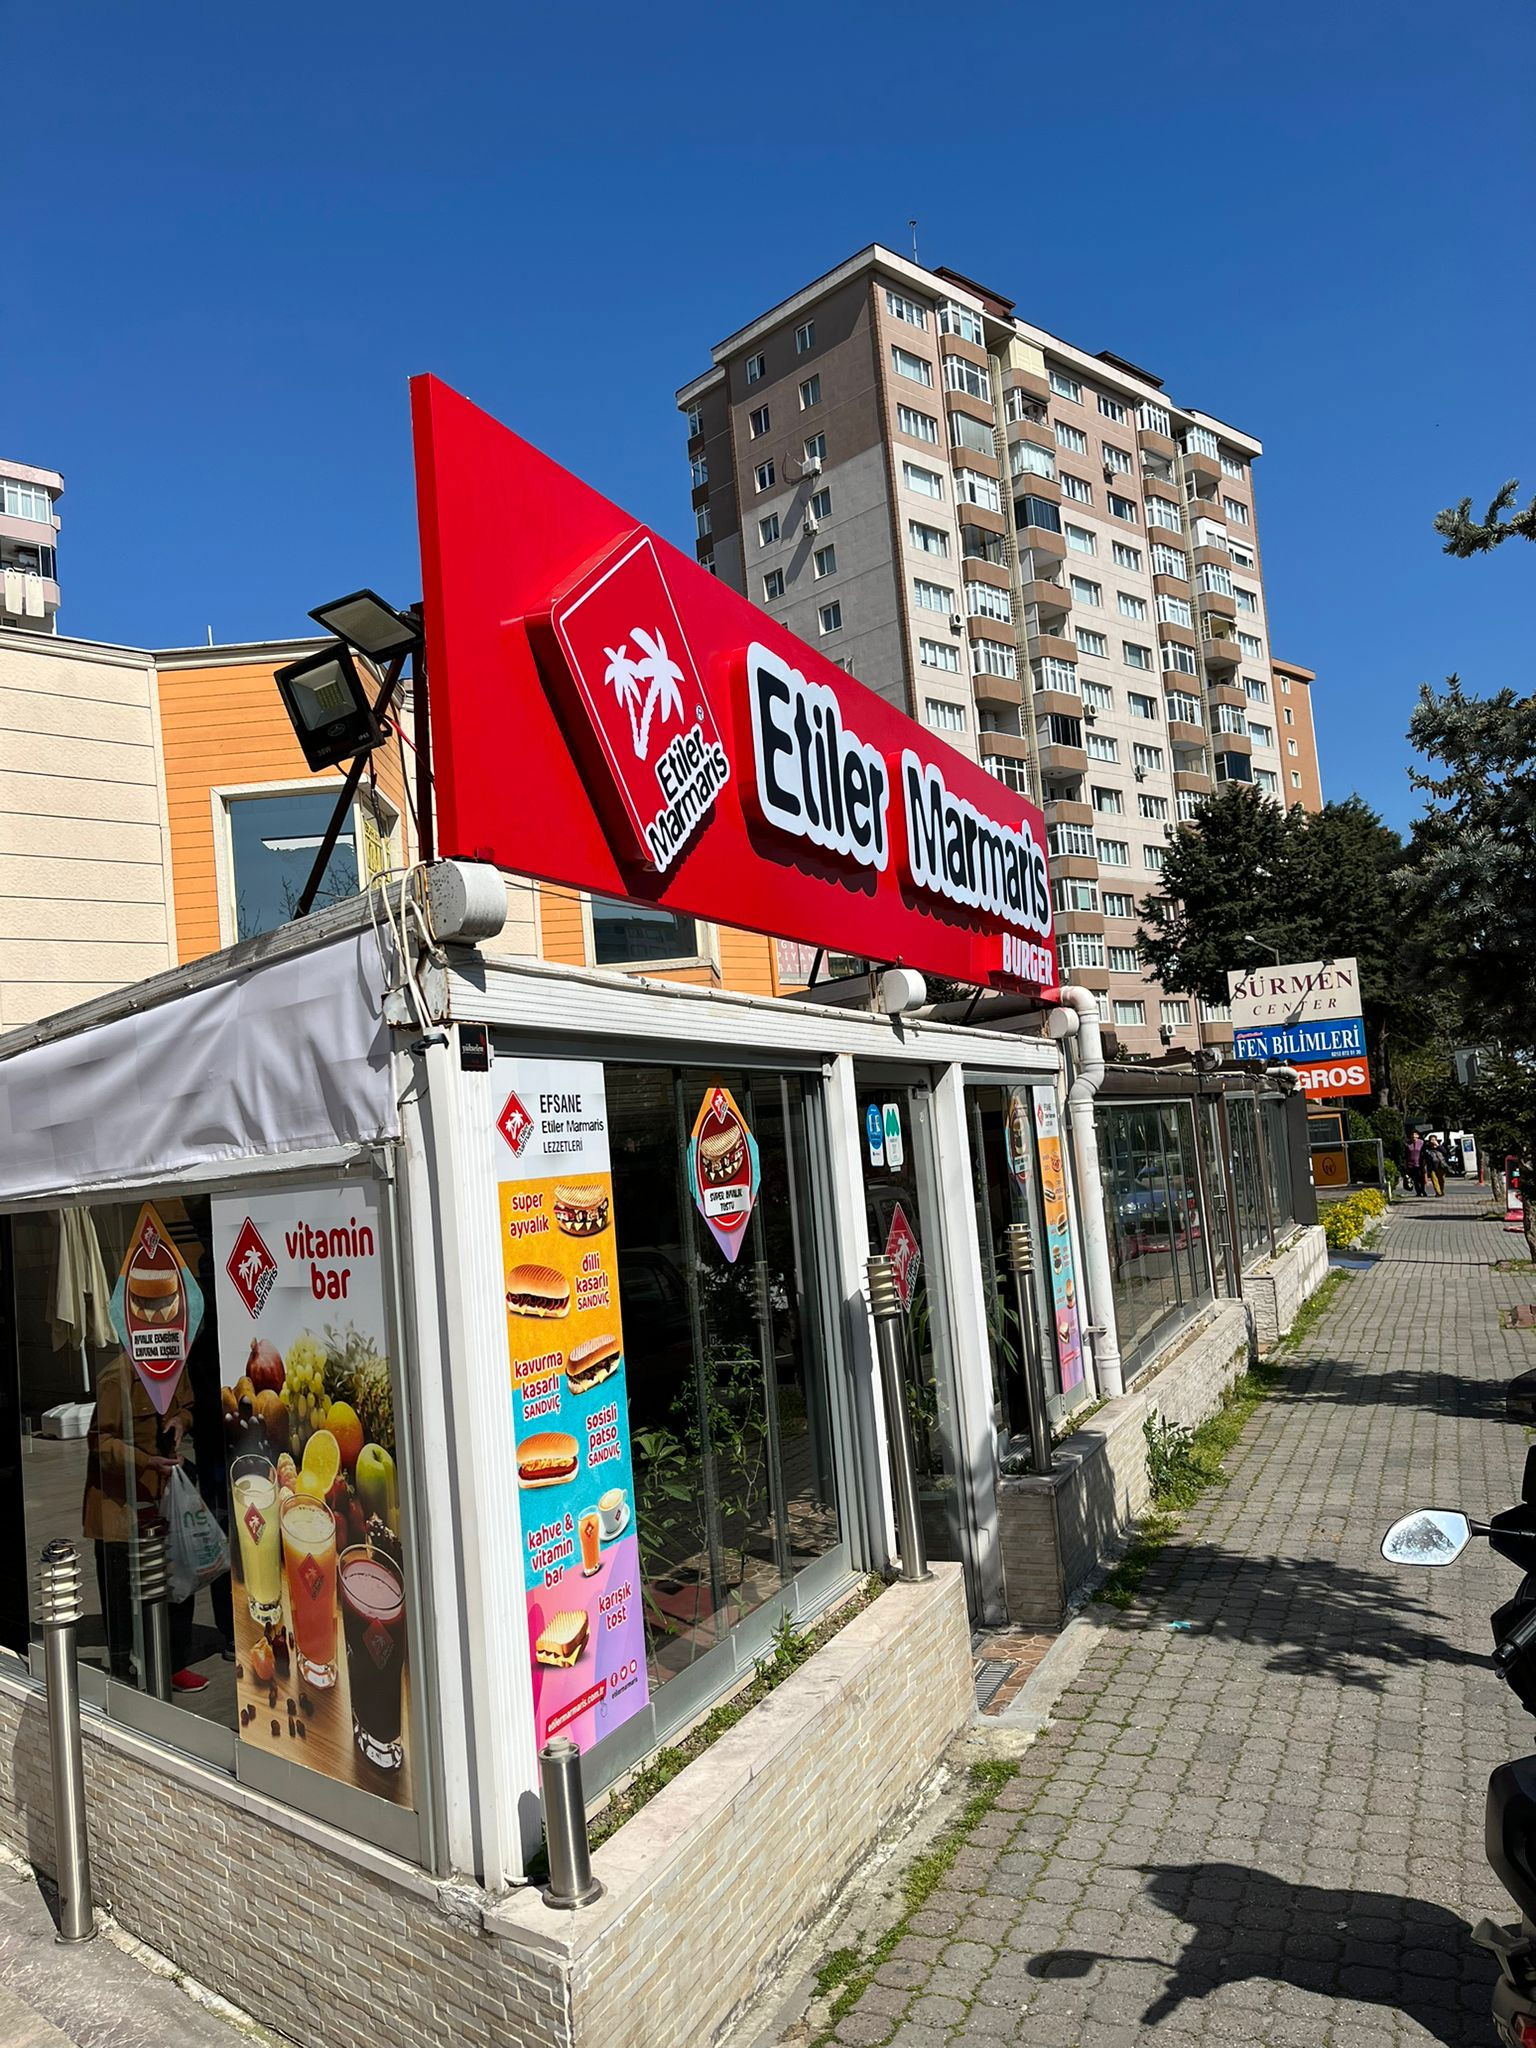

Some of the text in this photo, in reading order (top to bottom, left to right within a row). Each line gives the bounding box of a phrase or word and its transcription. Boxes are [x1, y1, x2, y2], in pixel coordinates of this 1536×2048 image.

[657, 729, 705, 802] Etiler
[648, 747, 728, 865] Marmaris
[757, 668, 1048, 926] Etiler Marmaris
[1003, 932, 1053, 986] BURGER
[1234, 970, 1353, 1000] SÜRMEN
[1253, 998, 1338, 1016] CENTER
[1237, 1025, 1360, 1058] FEN BİLİMLERİ
[1296, 1066, 1366, 1090] GROS
[540, 1094, 582, 1113] EFSANE
[542, 1118, 604, 1134] Etiler Marmaris
[543, 1137, 583, 1153] LEZZETLERİ
[512, 1193, 544, 1212] süper
[285, 1217, 374, 1260] vitamin
[510, 1215, 549, 1239] ayvalık
[582, 1253, 600, 1272] dilli
[255, 1267, 270, 1297] Etiler
[311, 1262, 351, 1300] bar
[515, 1352, 563, 1378] kavurma
[587, 1403, 618, 1430] sosisli
[590, 1426, 617, 1451] patso
[528, 1513, 574, 1549] kahve &
[531, 1539, 573, 1572] vitamin
[545, 1566, 564, 1589] bar
[598, 1581, 632, 1613] karışık
[607, 1607, 627, 1630] tost
